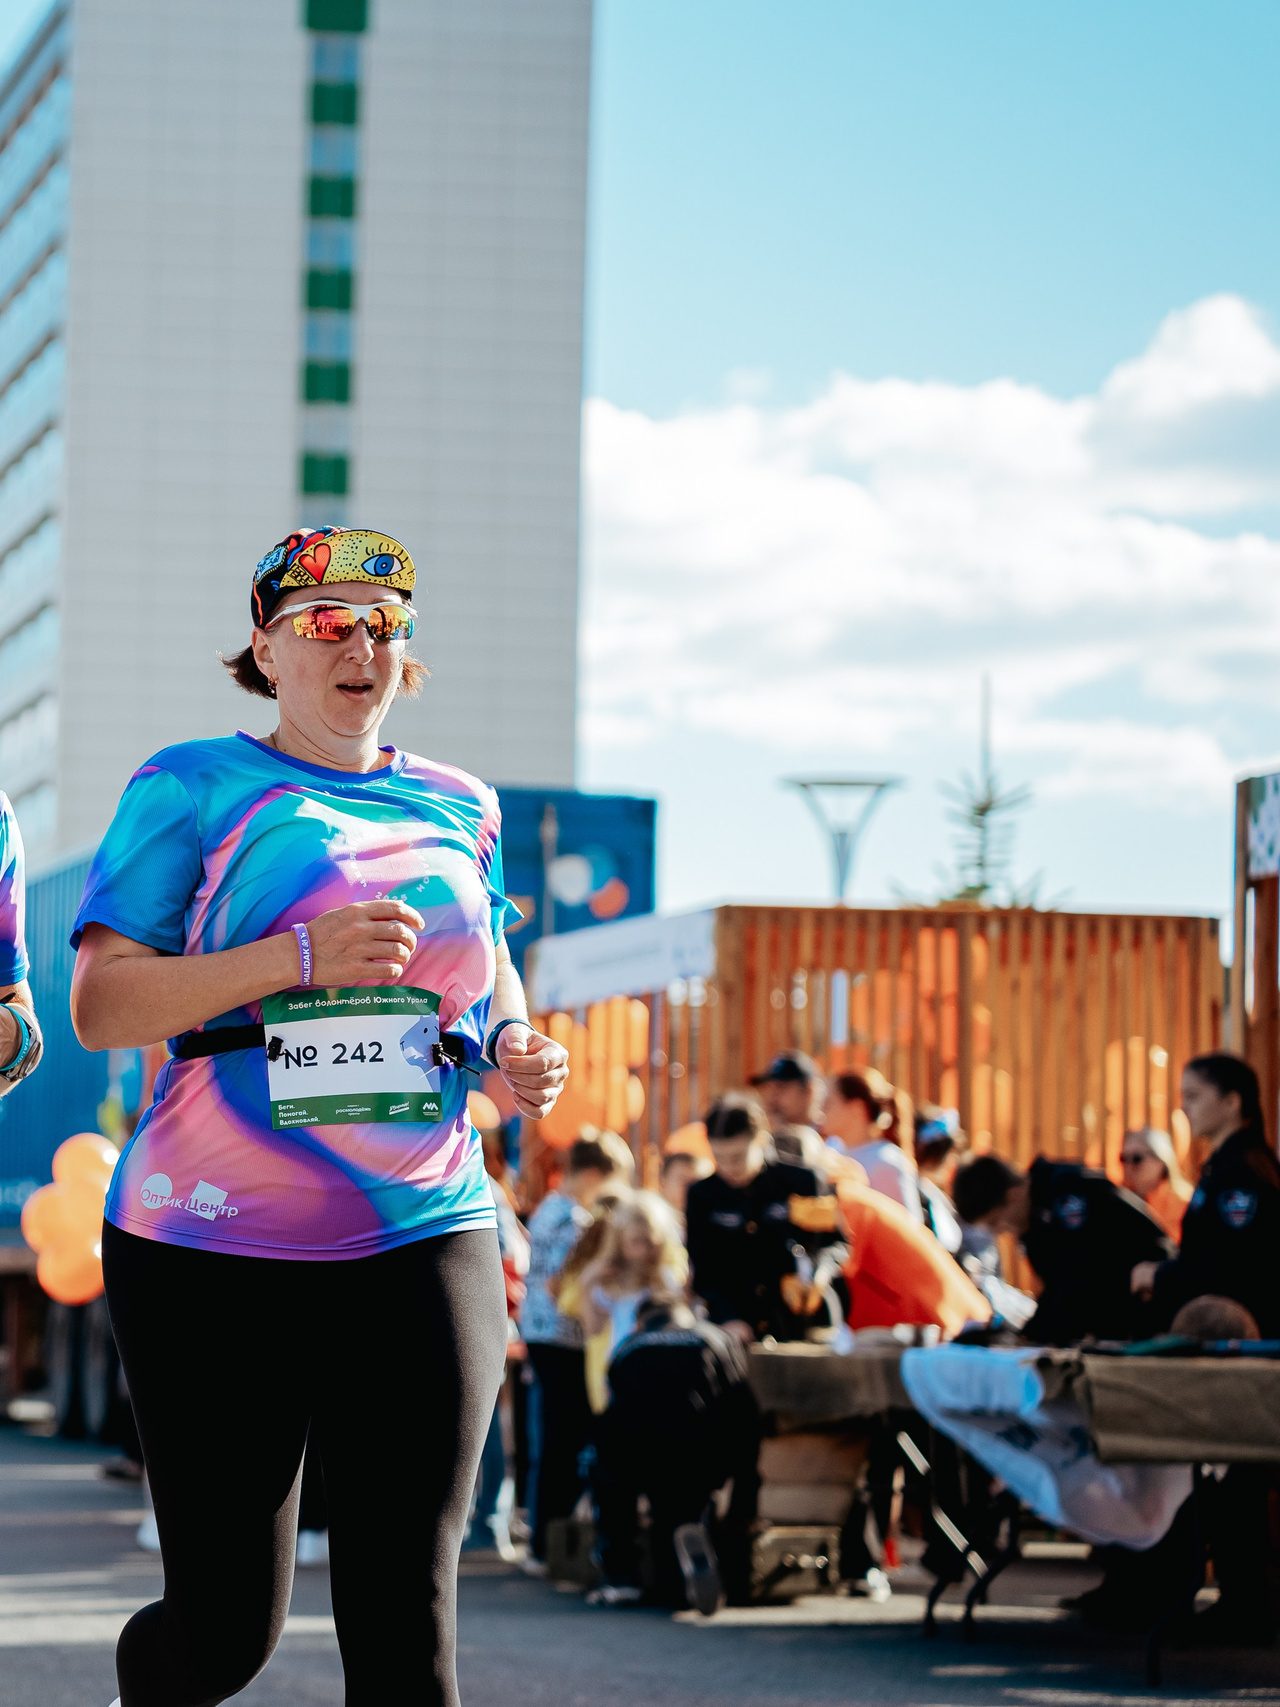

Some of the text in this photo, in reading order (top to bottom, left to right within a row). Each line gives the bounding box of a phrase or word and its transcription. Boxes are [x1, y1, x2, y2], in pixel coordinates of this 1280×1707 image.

[288, 995, 428, 1011] Забег волонтёров Южного Урала
[284, 1041, 384, 1070] № 242
[140, 1188, 239, 1218] Оптик Центр
